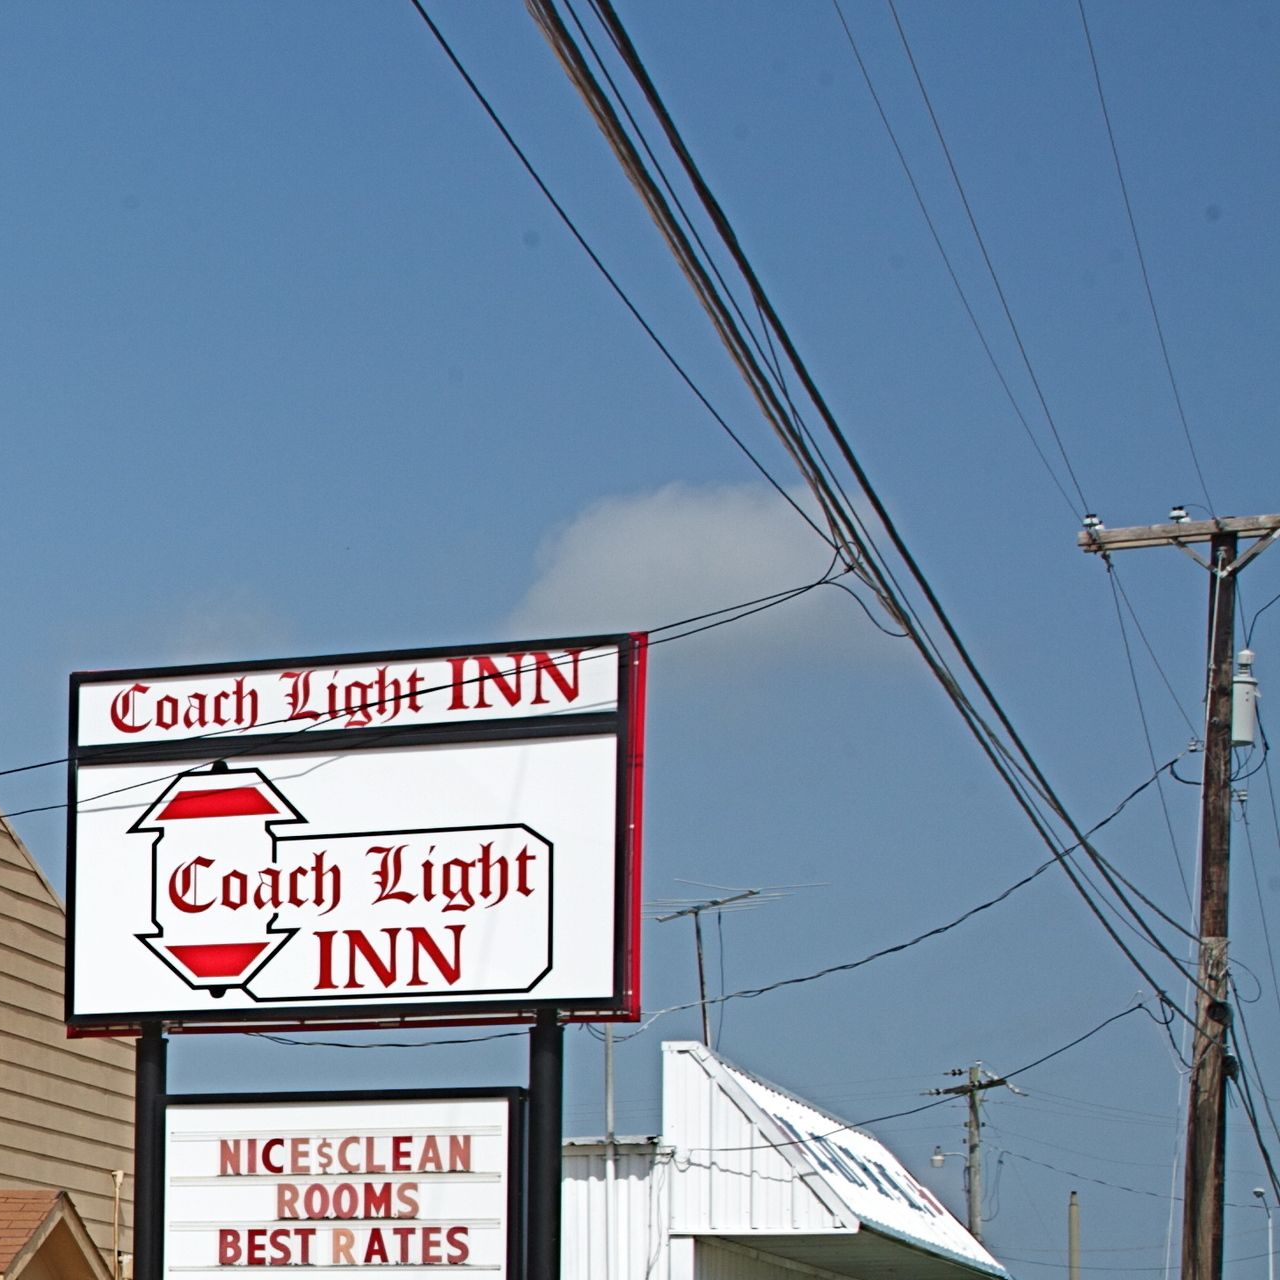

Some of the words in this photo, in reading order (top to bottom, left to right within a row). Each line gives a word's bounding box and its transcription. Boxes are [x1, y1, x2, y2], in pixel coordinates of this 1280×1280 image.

[110, 676, 260, 734] Coach
[279, 665, 424, 729] Light
[446, 648, 582, 711] INN
[168, 851, 342, 915] Coach
[366, 843, 537, 913] Light
[314, 924, 465, 990] INN
[277, 1182, 419, 1219] ROOMS
[218, 1227, 316, 1266] BEST
[332, 1226, 469, 1264] RATES
